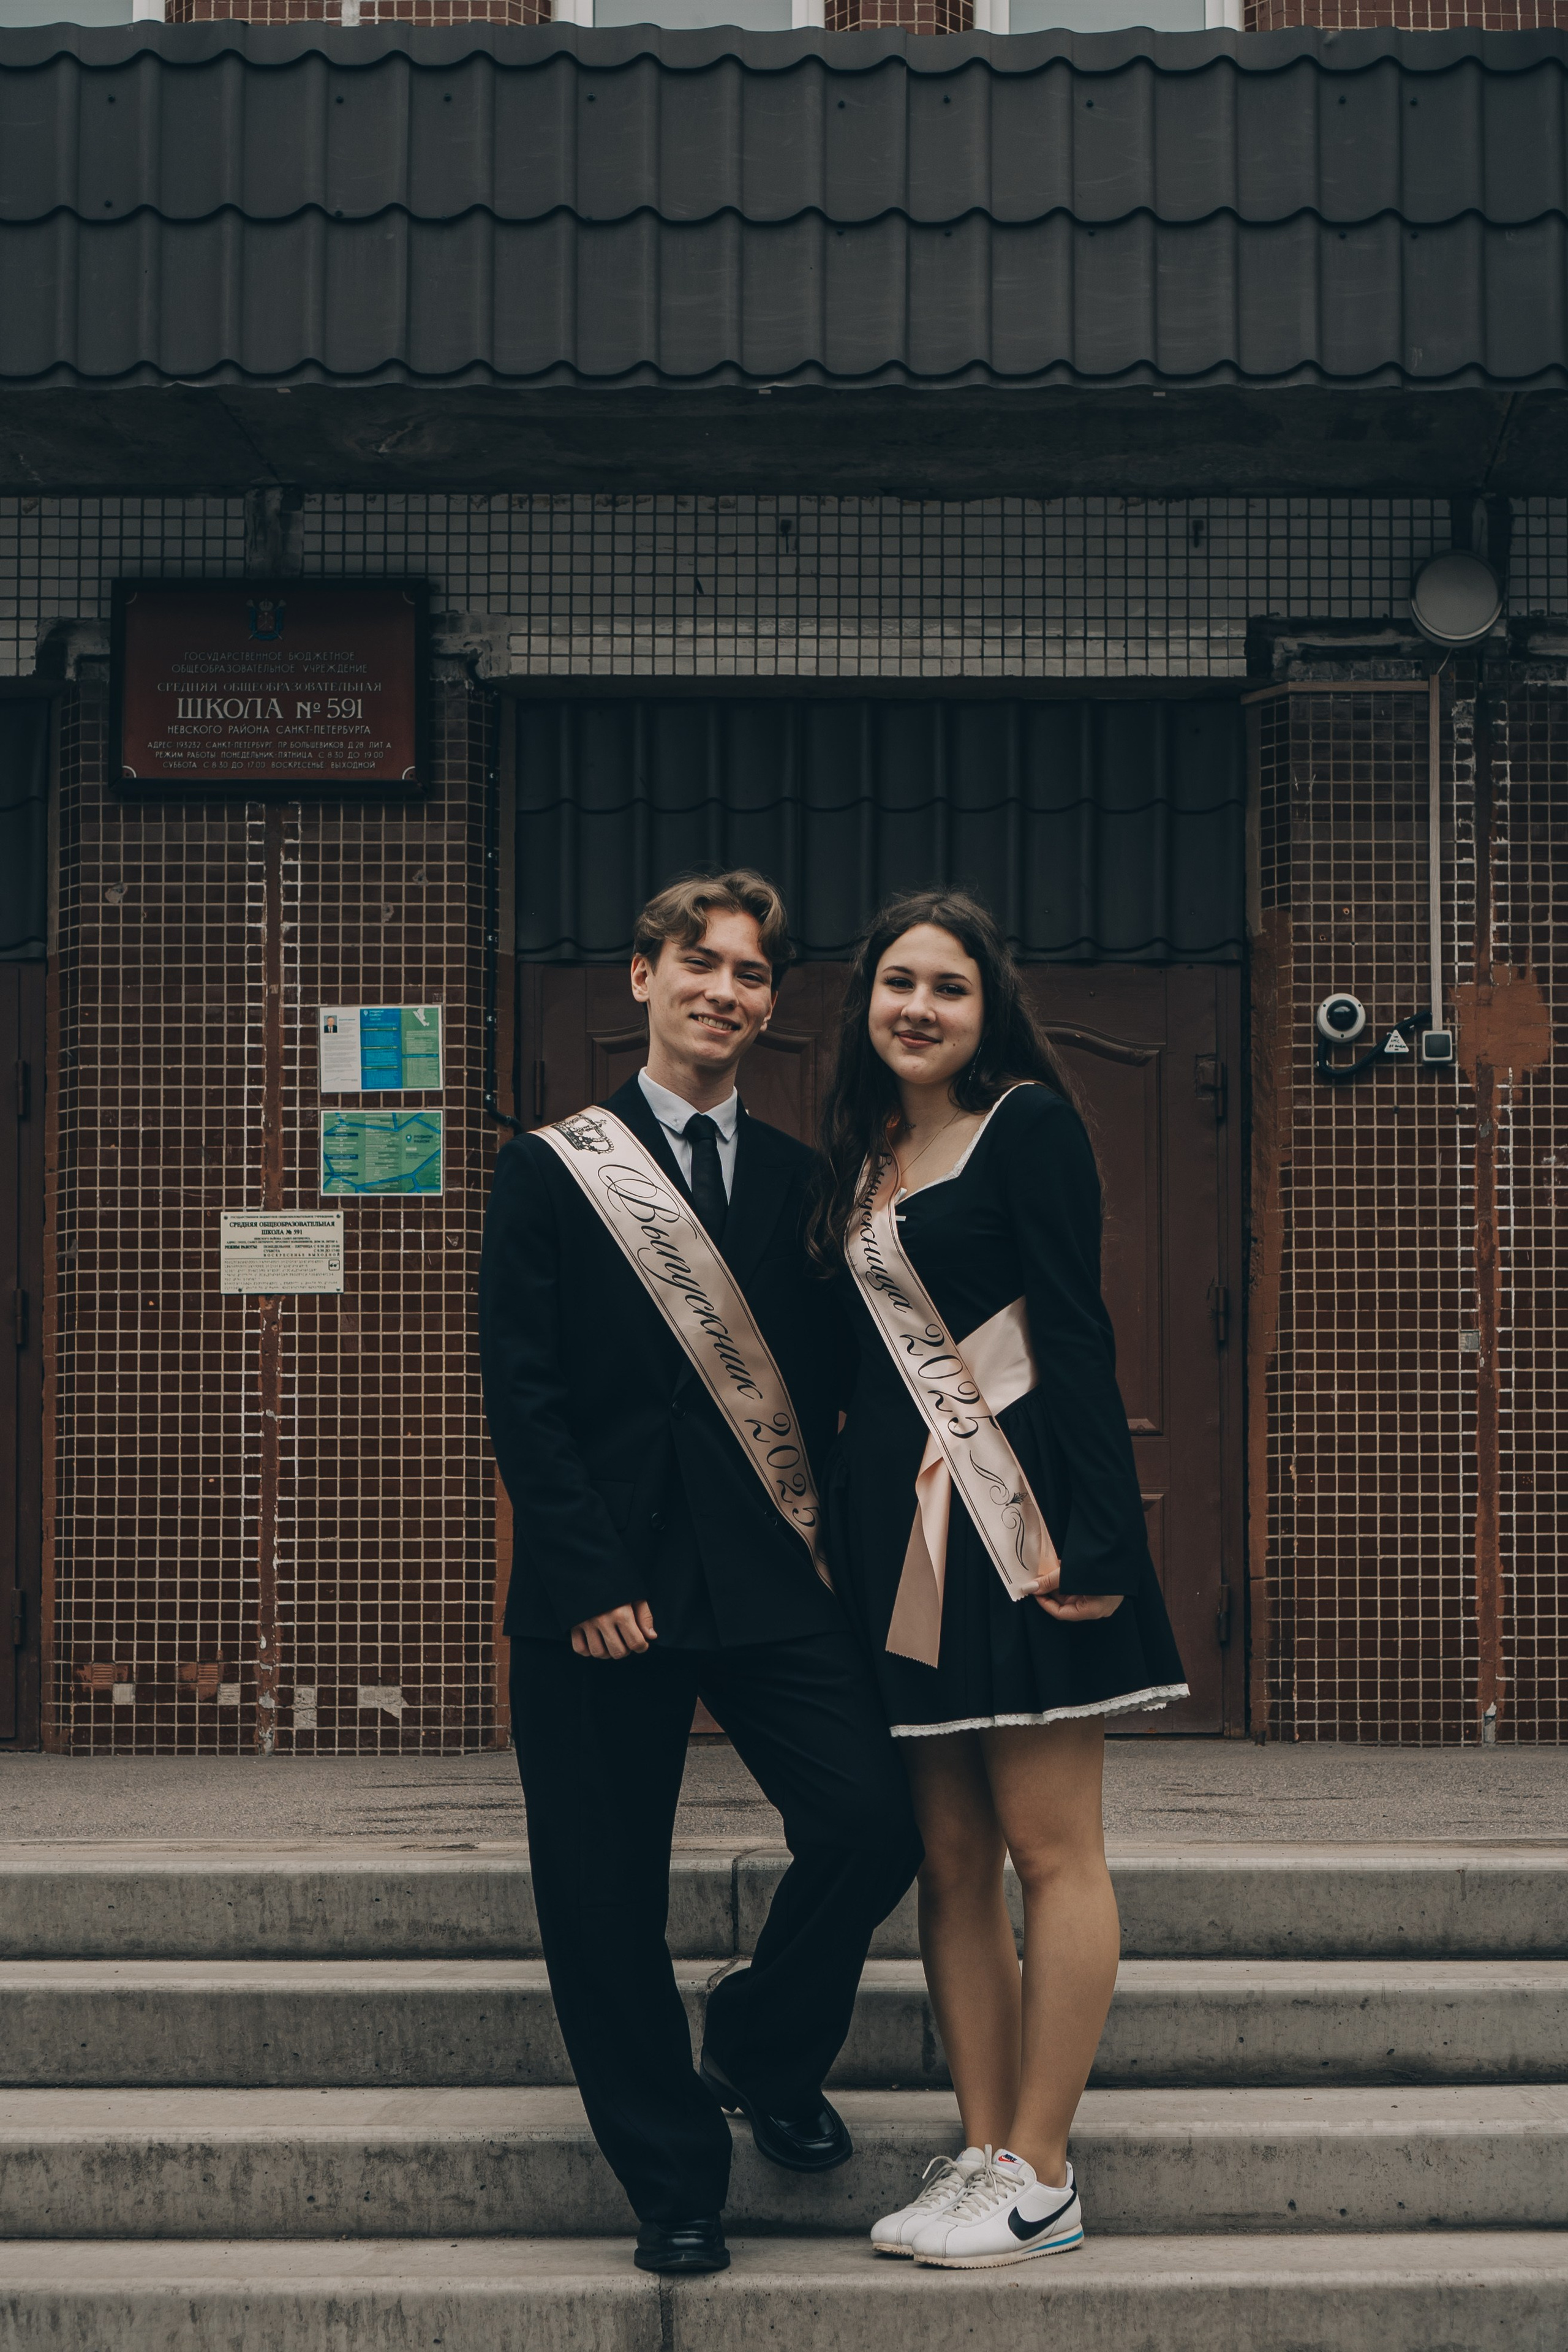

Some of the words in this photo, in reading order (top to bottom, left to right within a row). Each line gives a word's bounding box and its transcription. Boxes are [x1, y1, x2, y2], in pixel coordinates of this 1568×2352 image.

[184, 651, 282, 661] ГОСУДАРСТВЕННОЕ
[288, 651, 355, 661] БЮДЖЕТНОЕ
[172, 663, 295, 673] ОБЩЕОБРАЗОВАТЕЛЬНОЕ
[303, 663, 368, 673] УЧРЕЖДЕНИЕ
[157, 682, 217, 692] СРЕДНЯЯ
[224, 682, 382, 692] ОБЩЕОБРАЗОВАТЕЛЬНАЯ
[176, 698, 284, 718] ШКОЛА
[296, 701, 320, 718] №
[326, 698, 363, 718] 591
[168, 725, 222, 734] НЕВСКОГО
[228, 723, 270, 734] РАЙОНА
[276, 725, 371, 734] САНКТ-ПЕТЕРБУРГА
[331, 760, 375, 769] ВЫХОДНОЙ
[597, 1163, 765, 1400] Выпускник
[744, 1412, 822, 1527] 2025
[900, 1323, 1000, 1439] 2025
[1003, 2154, 1017, 2162] NIKE
